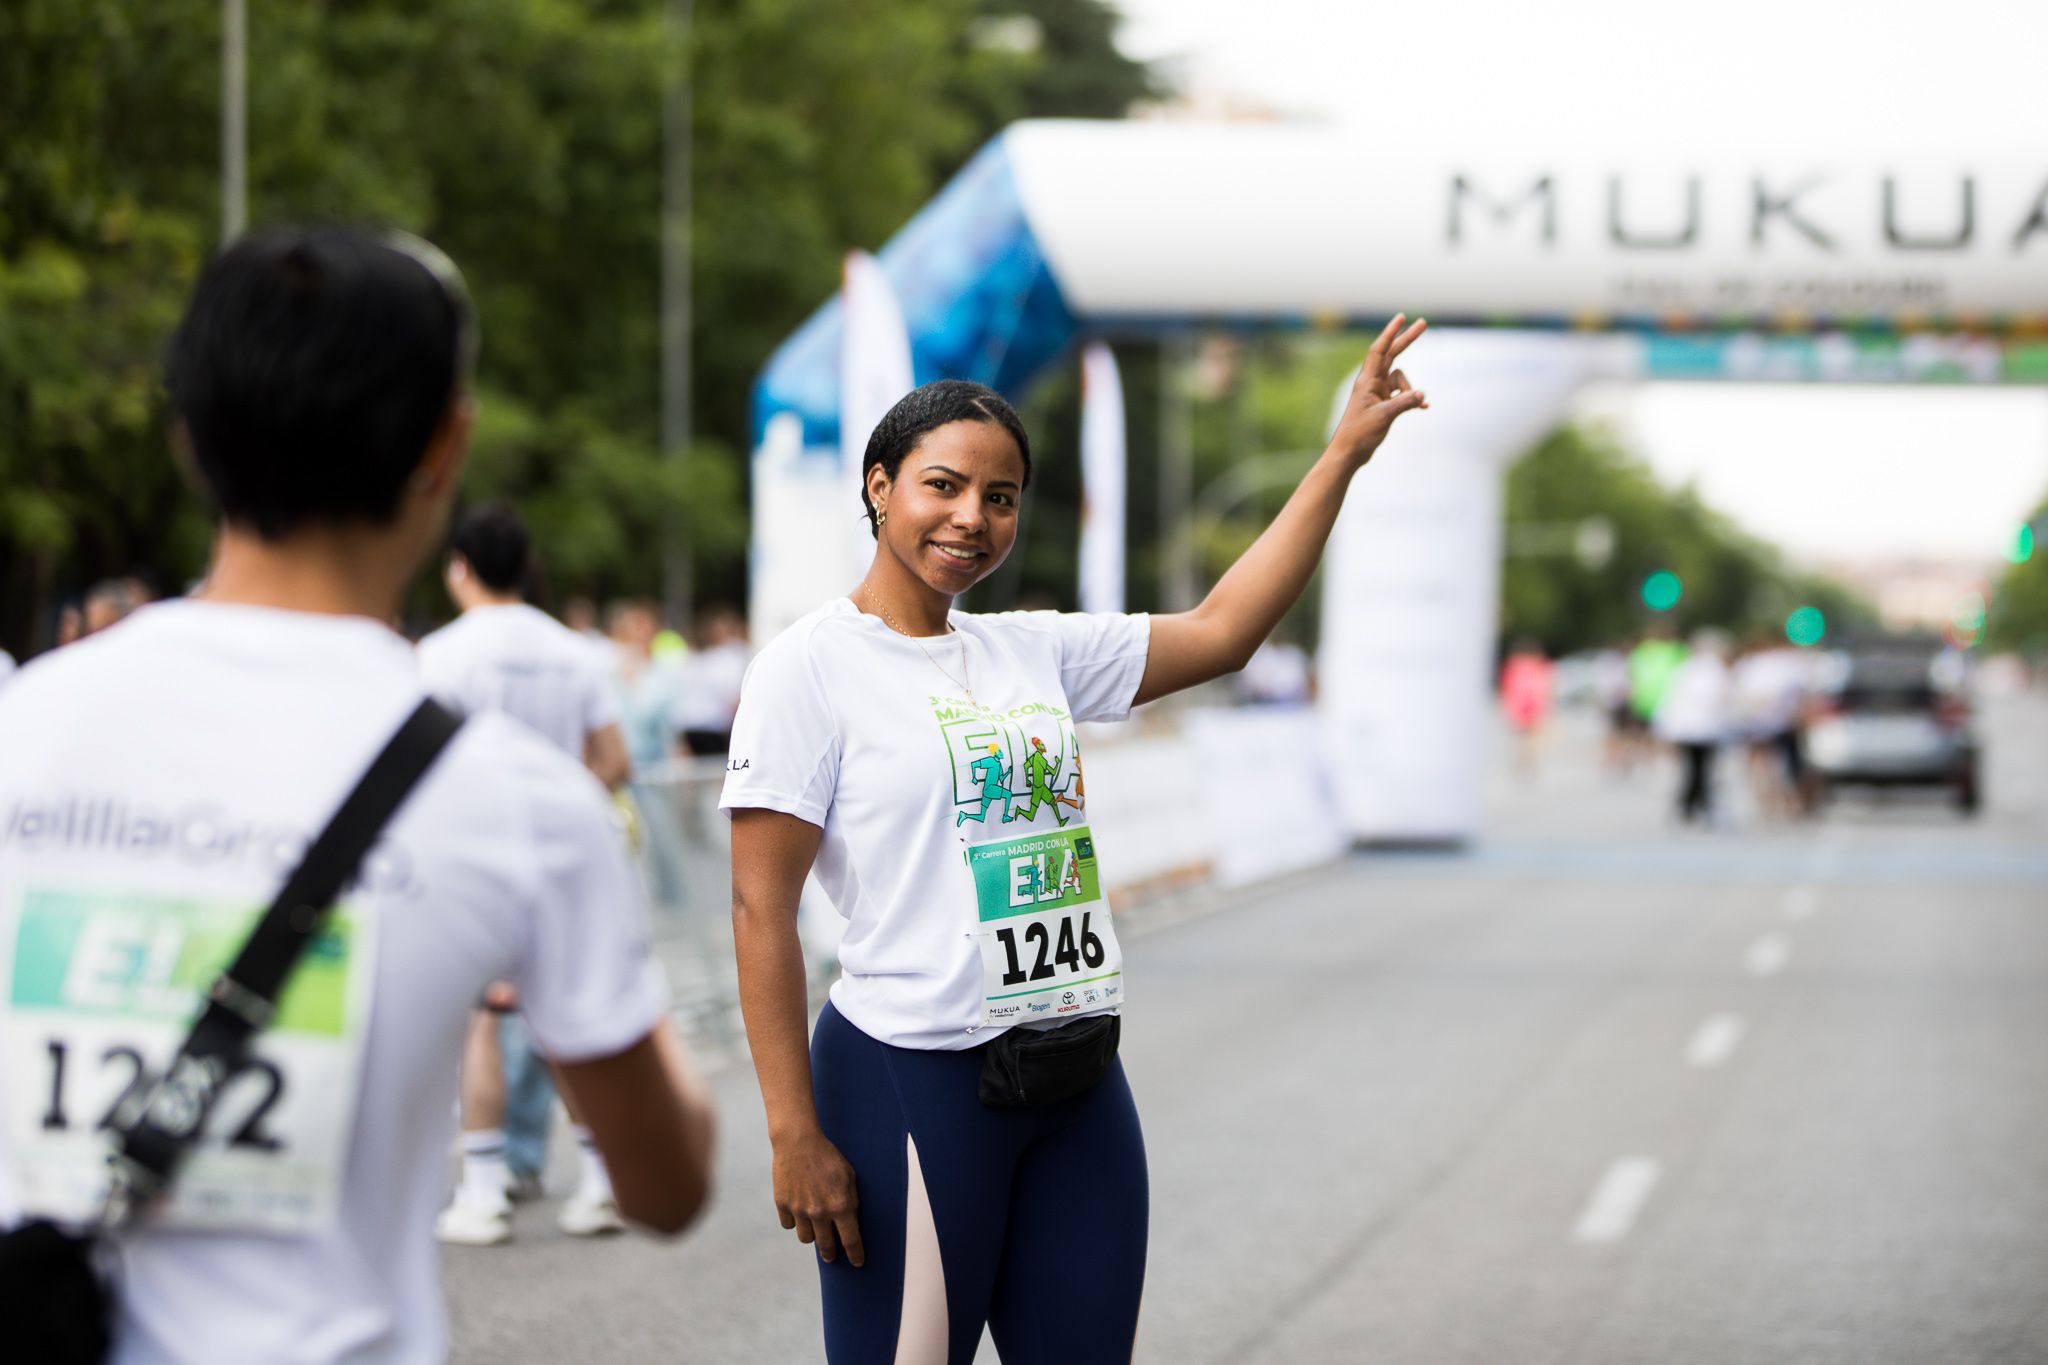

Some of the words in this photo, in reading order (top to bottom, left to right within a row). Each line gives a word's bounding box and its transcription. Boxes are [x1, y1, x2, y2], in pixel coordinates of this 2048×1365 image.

[726, 758, 750, 771] LA
[981, 849, 1006, 859] Carrera
[1008, 841, 1044, 856] MADRID
[1009, 848, 1082, 908] ELA
[996, 911, 1105, 986] 1246
[989, 1006, 1020, 1014] MUKUA
[42, 1040, 284, 1151] 122
